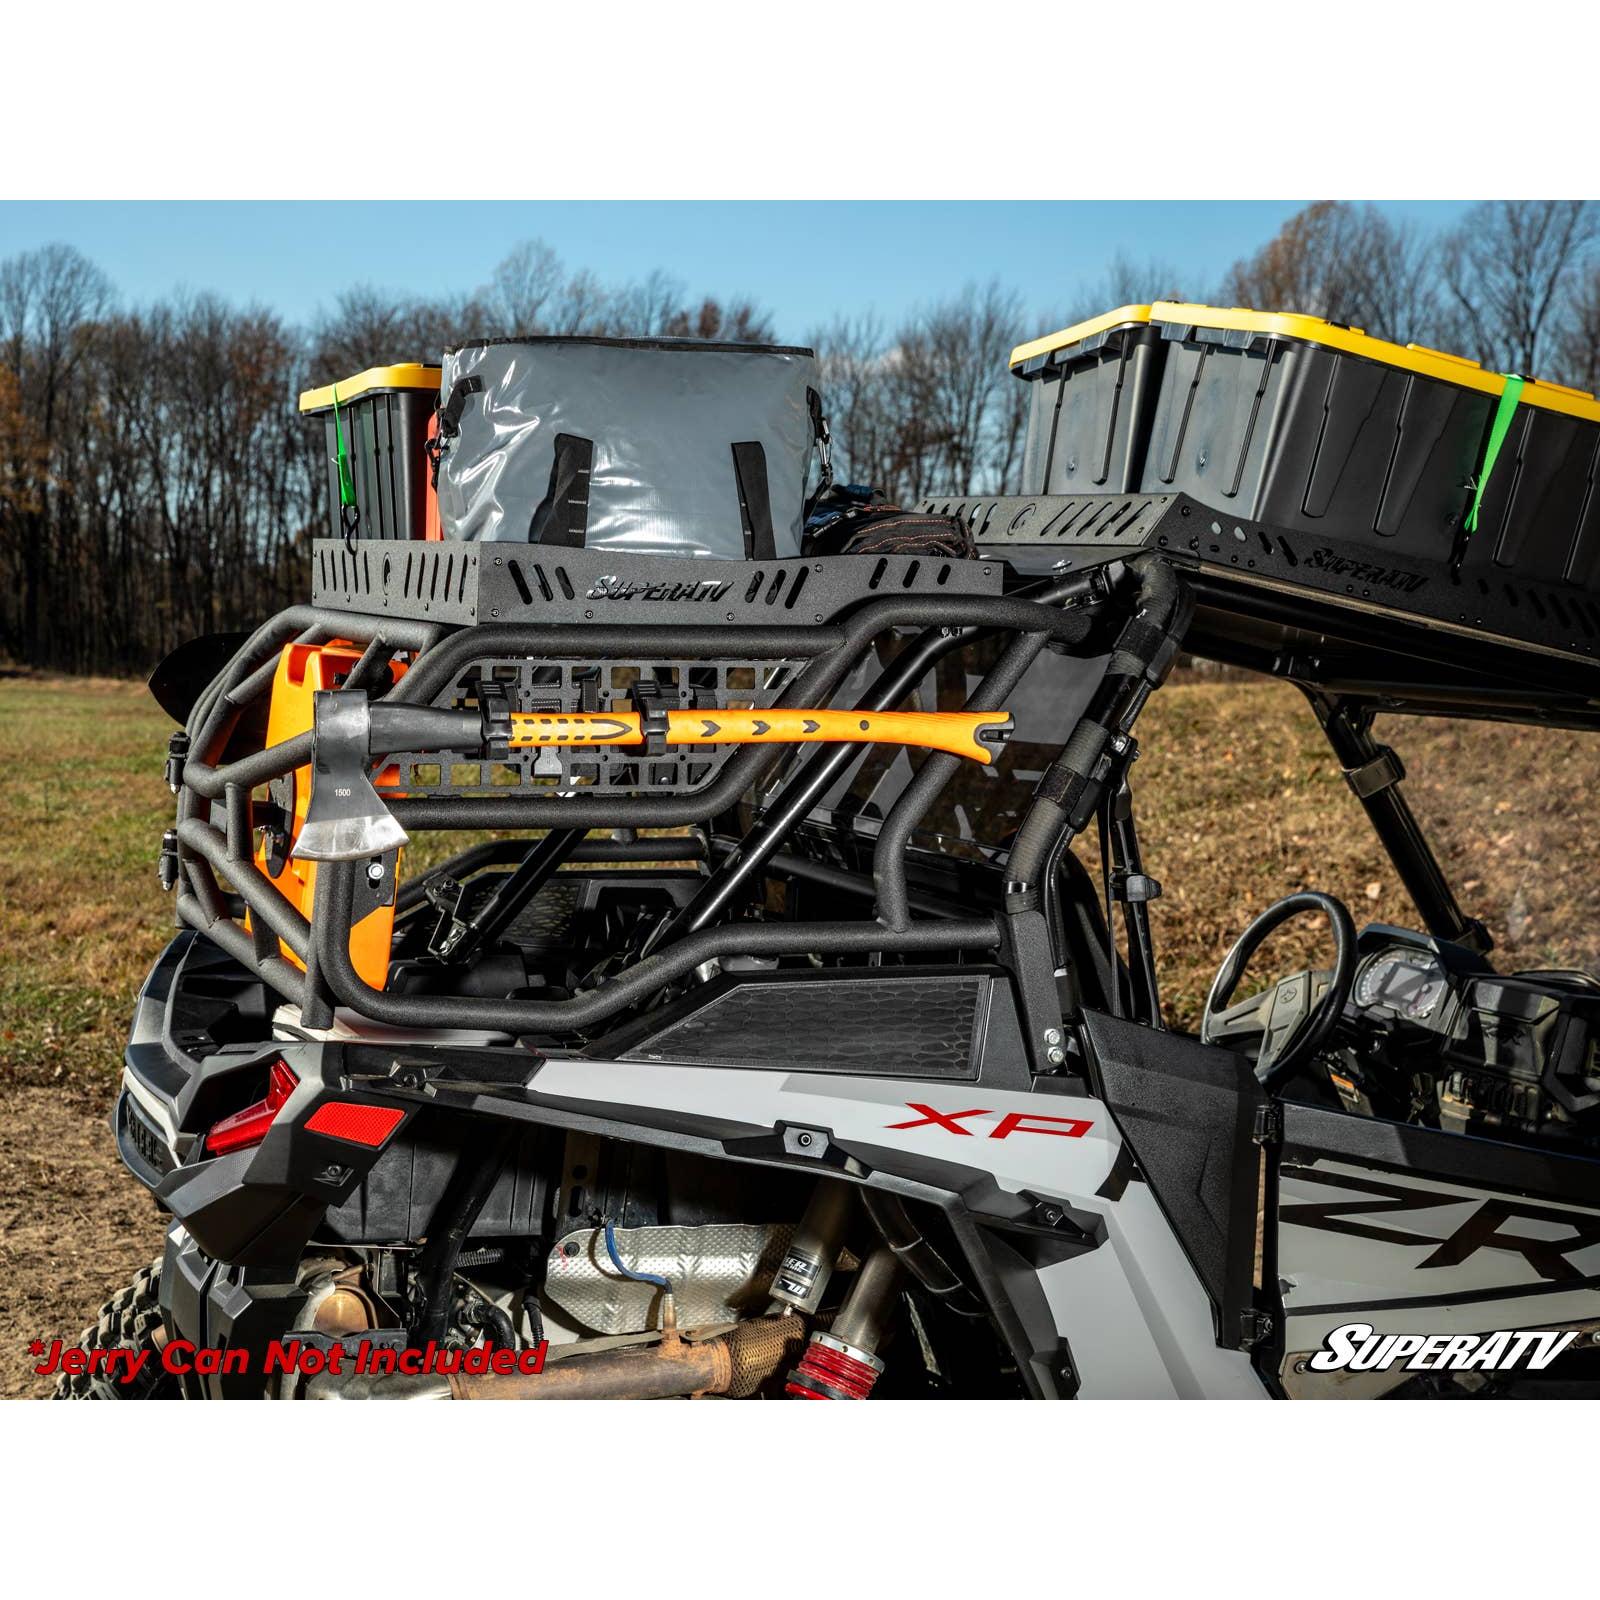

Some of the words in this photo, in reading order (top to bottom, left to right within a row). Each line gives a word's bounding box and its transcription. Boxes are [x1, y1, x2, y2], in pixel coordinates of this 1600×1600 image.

[586, 575, 735, 601] SUPERATV
[334, 788, 351, 797] 1500
[883, 1102, 1095, 1140] XP
